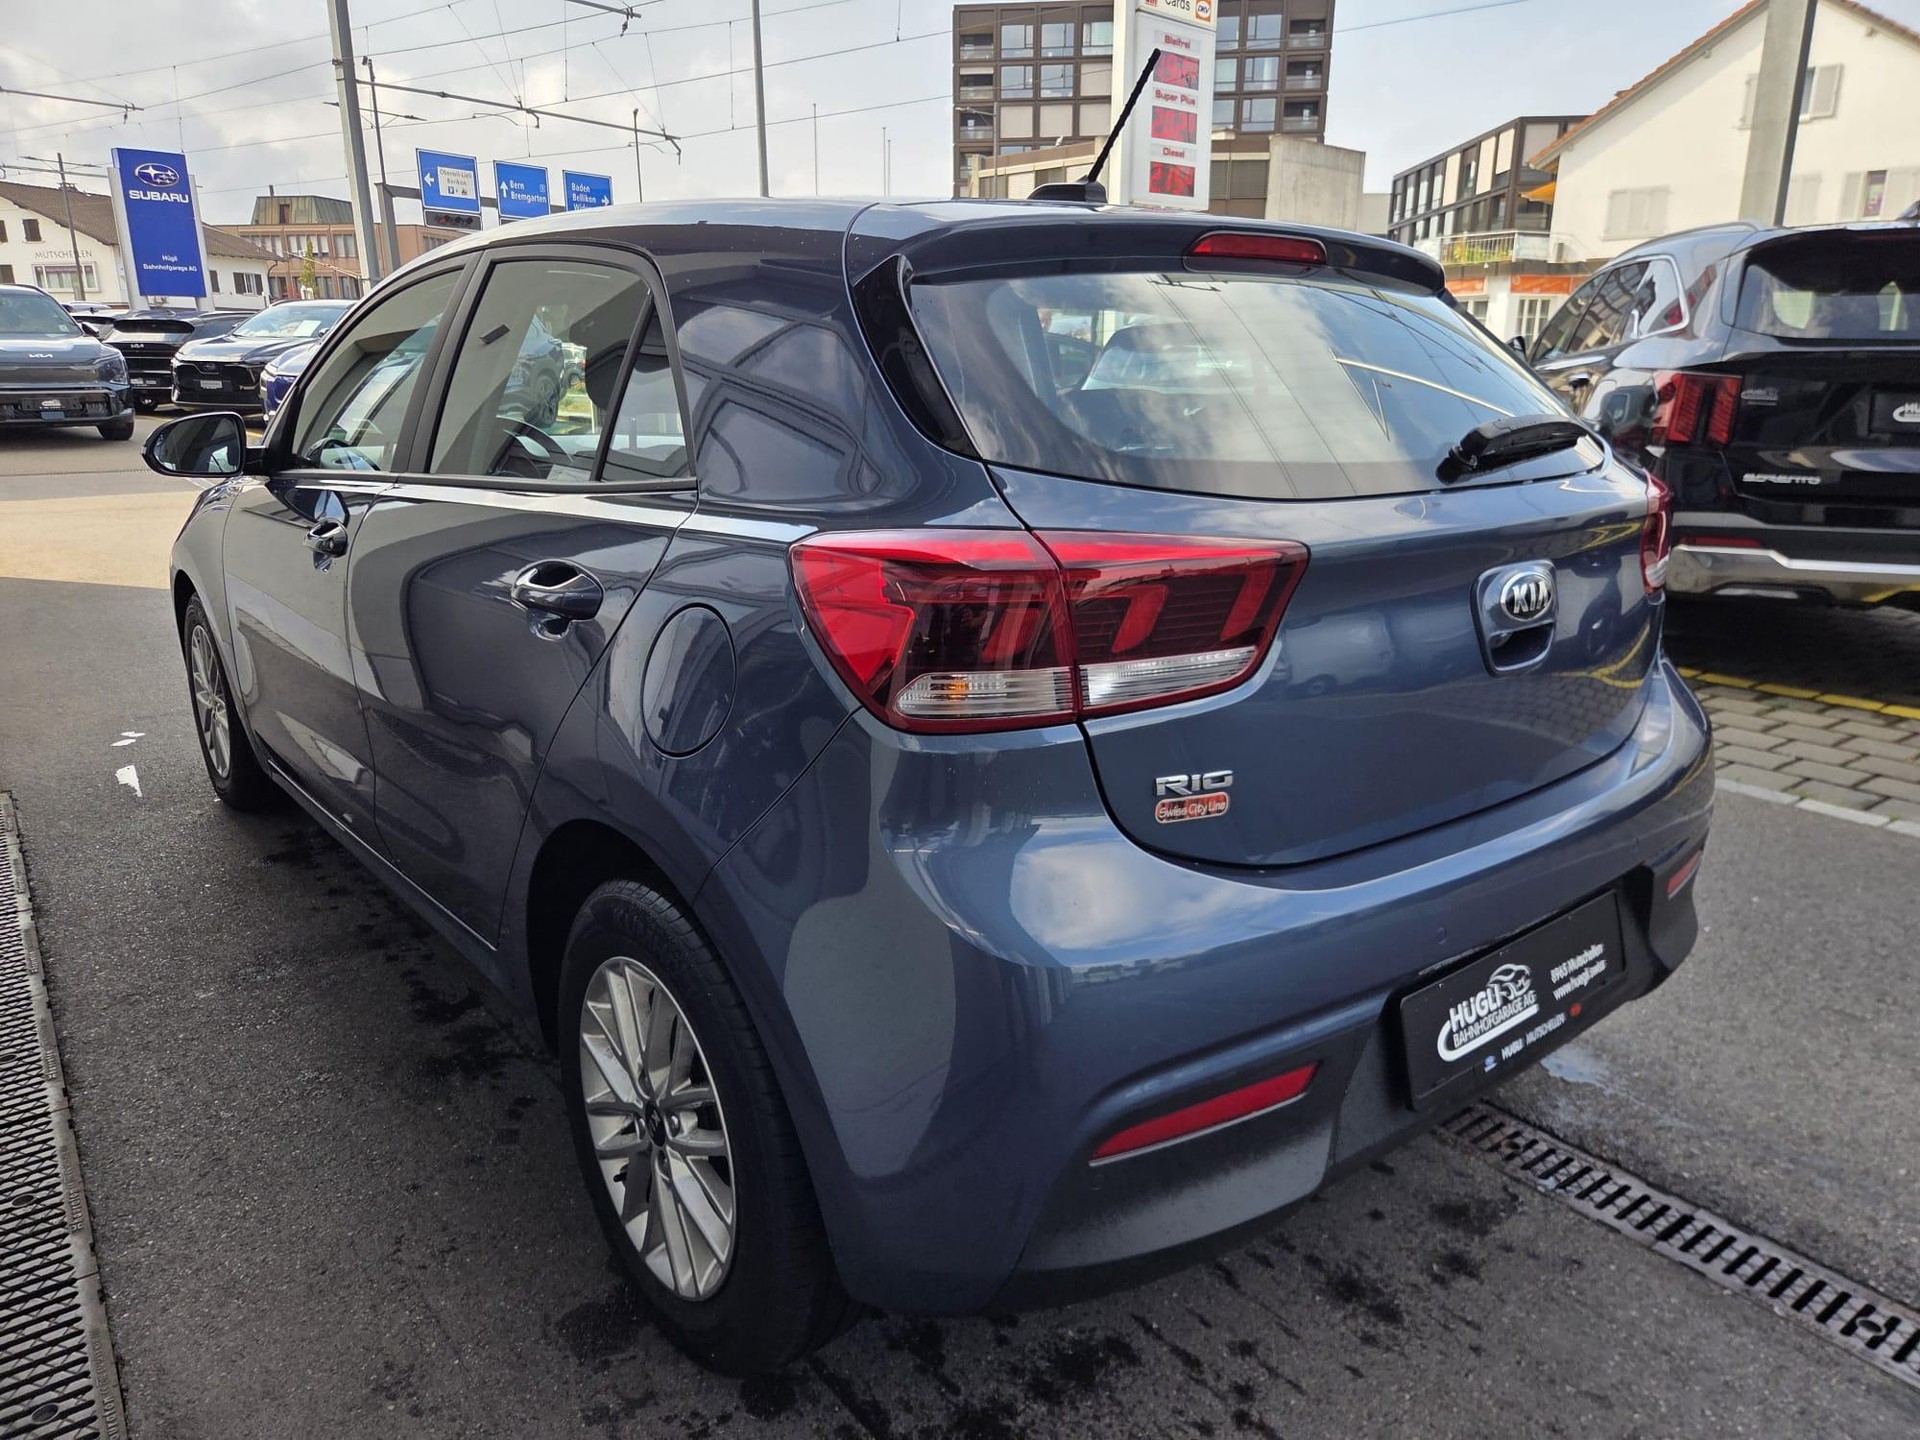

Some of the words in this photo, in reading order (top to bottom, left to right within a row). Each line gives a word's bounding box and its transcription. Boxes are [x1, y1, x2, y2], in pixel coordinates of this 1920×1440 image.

[1164, 34, 1191, 49] Bleifrei
[1155, 89, 1178, 102] Super
[1180, 94, 1196, 106] Plus
[1163, 147, 1185, 158] Diesel
[510, 180, 525, 190] Bern
[571, 182, 590, 193] Baden
[128, 189, 190, 204] SUBARU
[511, 191, 547, 203] Bremgarten
[572, 193, 597, 204] Bellikon
[35, 249, 93, 259] MUTSCHELEN
[161, 254, 178, 263] Hügli
[143, 263, 187, 273] Bahnhofgarage
[1512, 580, 1550, 614] KIA
[1156, 770, 1233, 795] RIO
[1159, 806, 1188, 819] Swiss
[1188, 803, 1207, 816] City
[1208, 800, 1226, 812] Line
[1449, 983, 1502, 1033] HÜGLI
[1453, 996, 1525, 1049] BAHNHOFGARAGE
[1523, 990, 1537, 1009] AG
